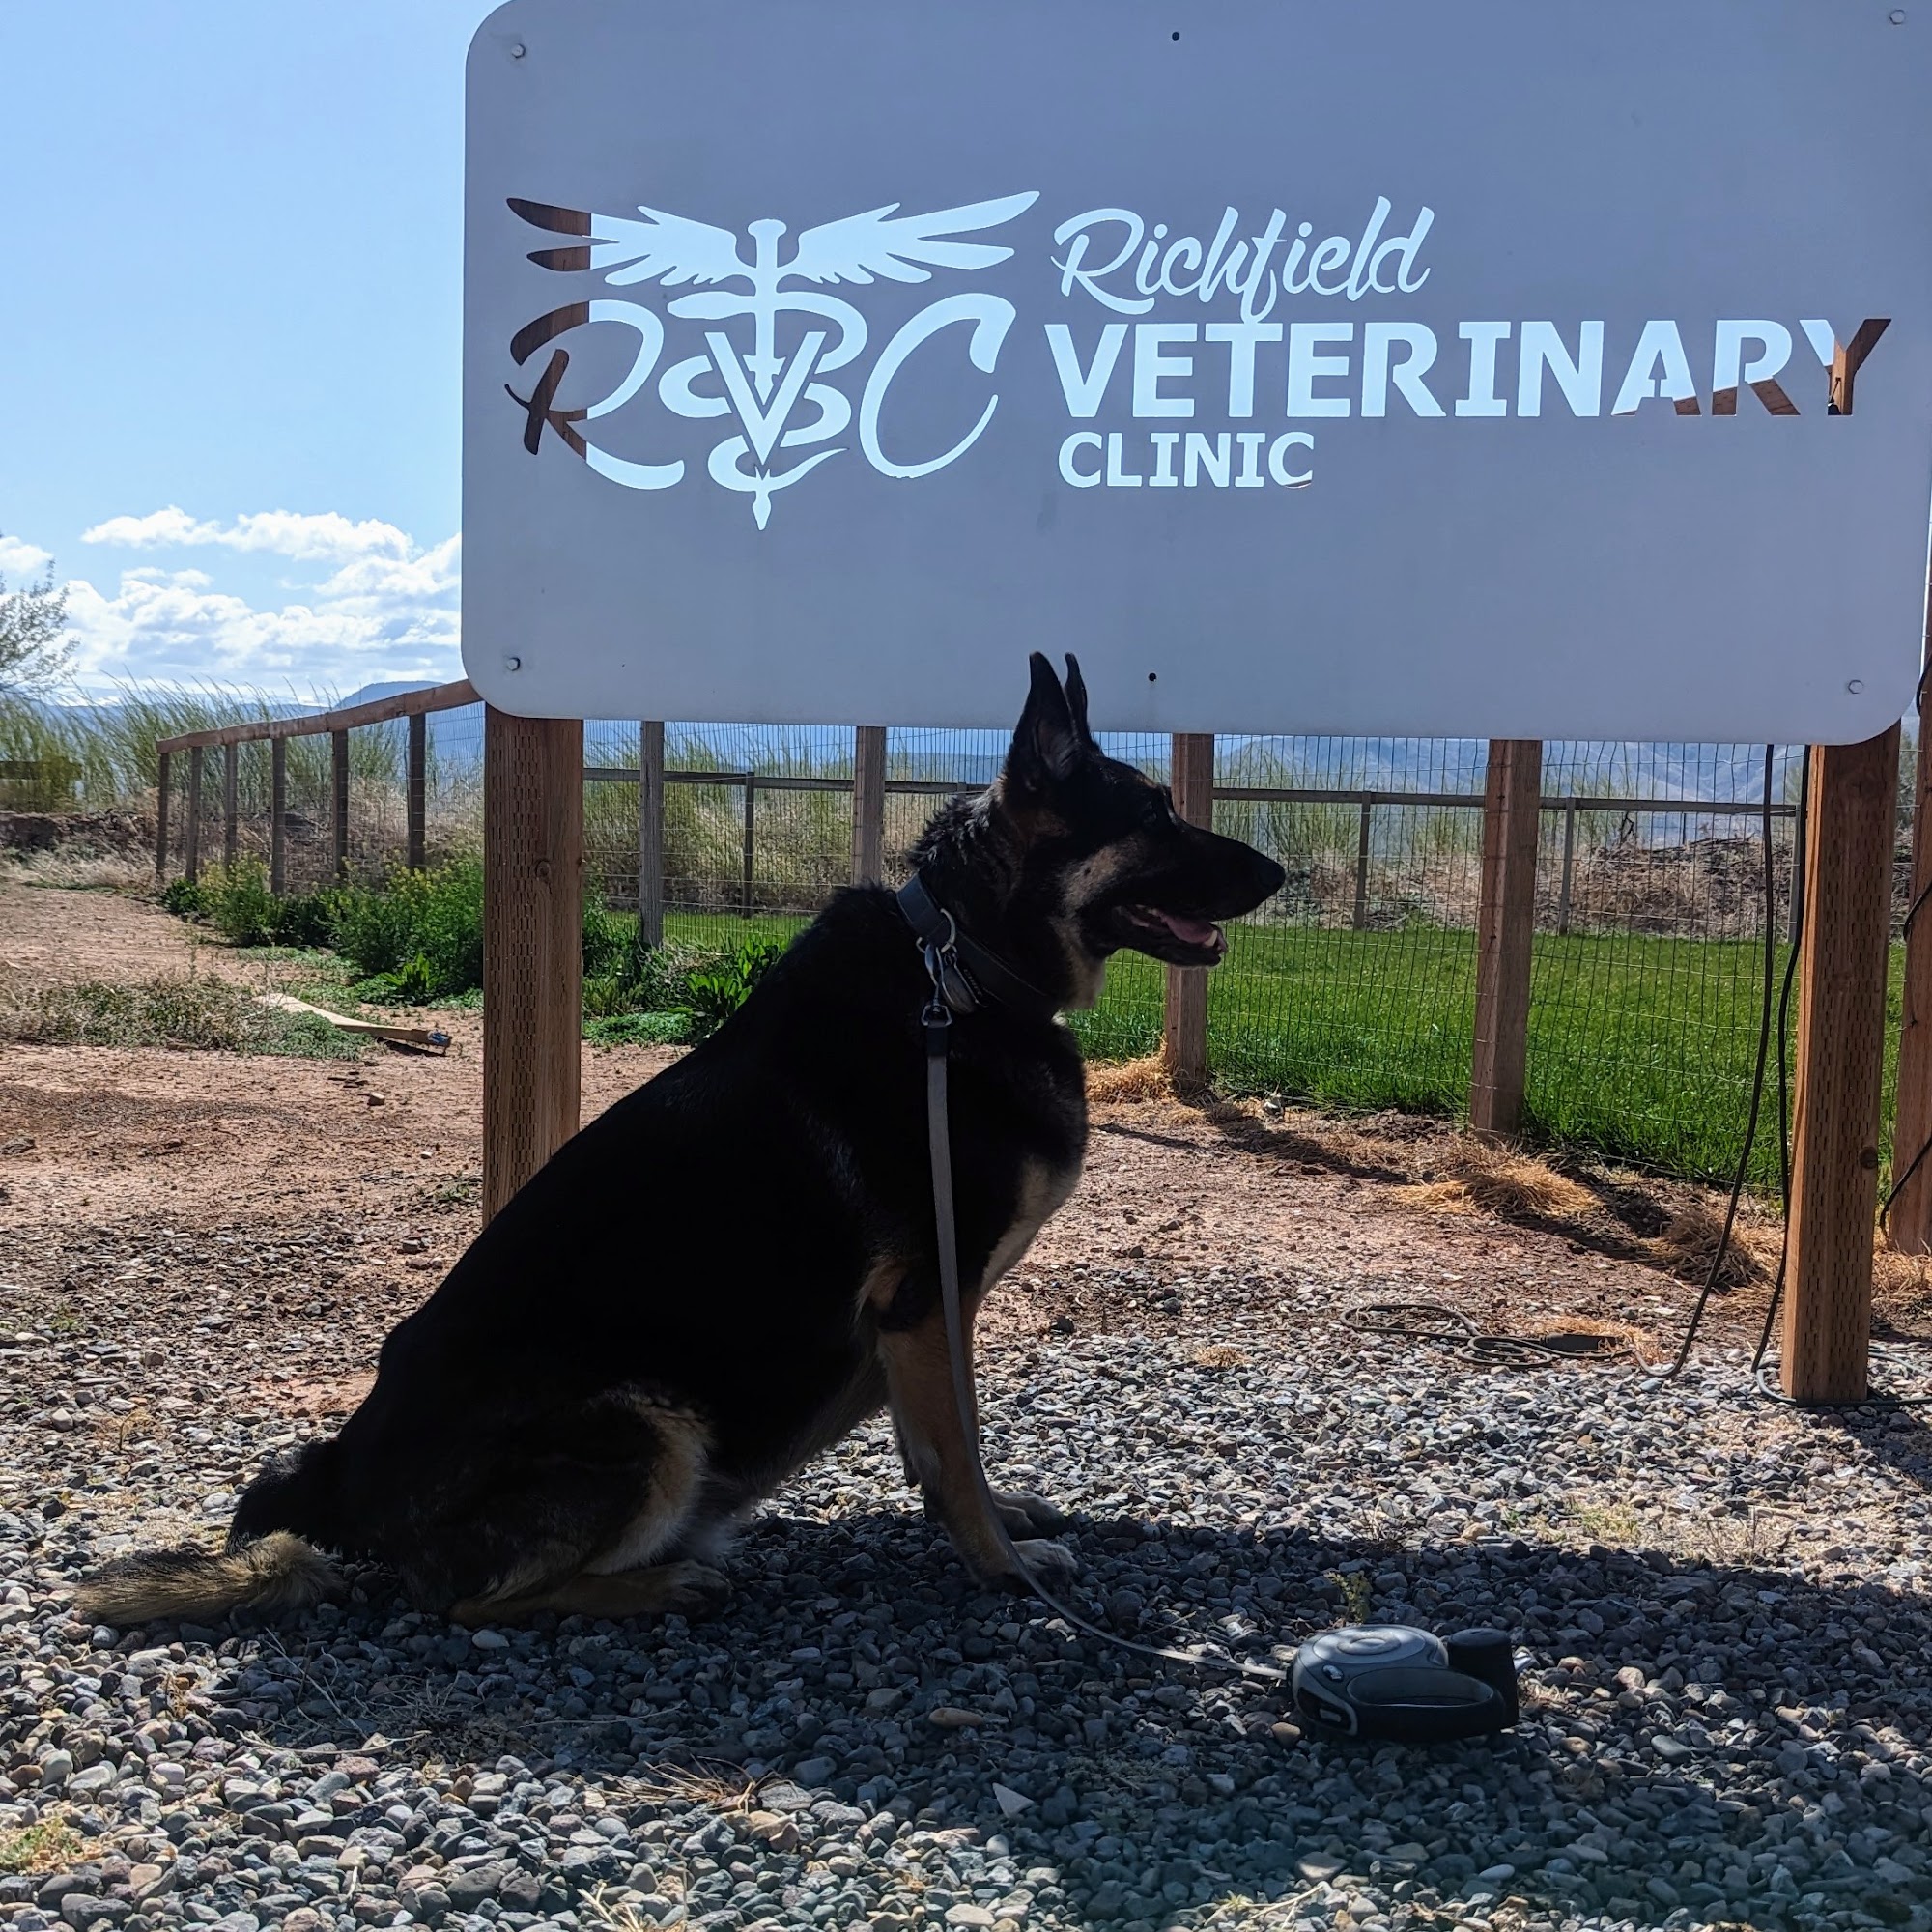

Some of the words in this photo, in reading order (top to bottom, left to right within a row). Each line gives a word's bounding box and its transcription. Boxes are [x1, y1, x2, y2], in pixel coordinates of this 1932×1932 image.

[1051, 196, 1435, 324] Richfield
[1043, 318, 1892, 418] VETERINARY
[1058, 432, 1315, 489] CLINIC
